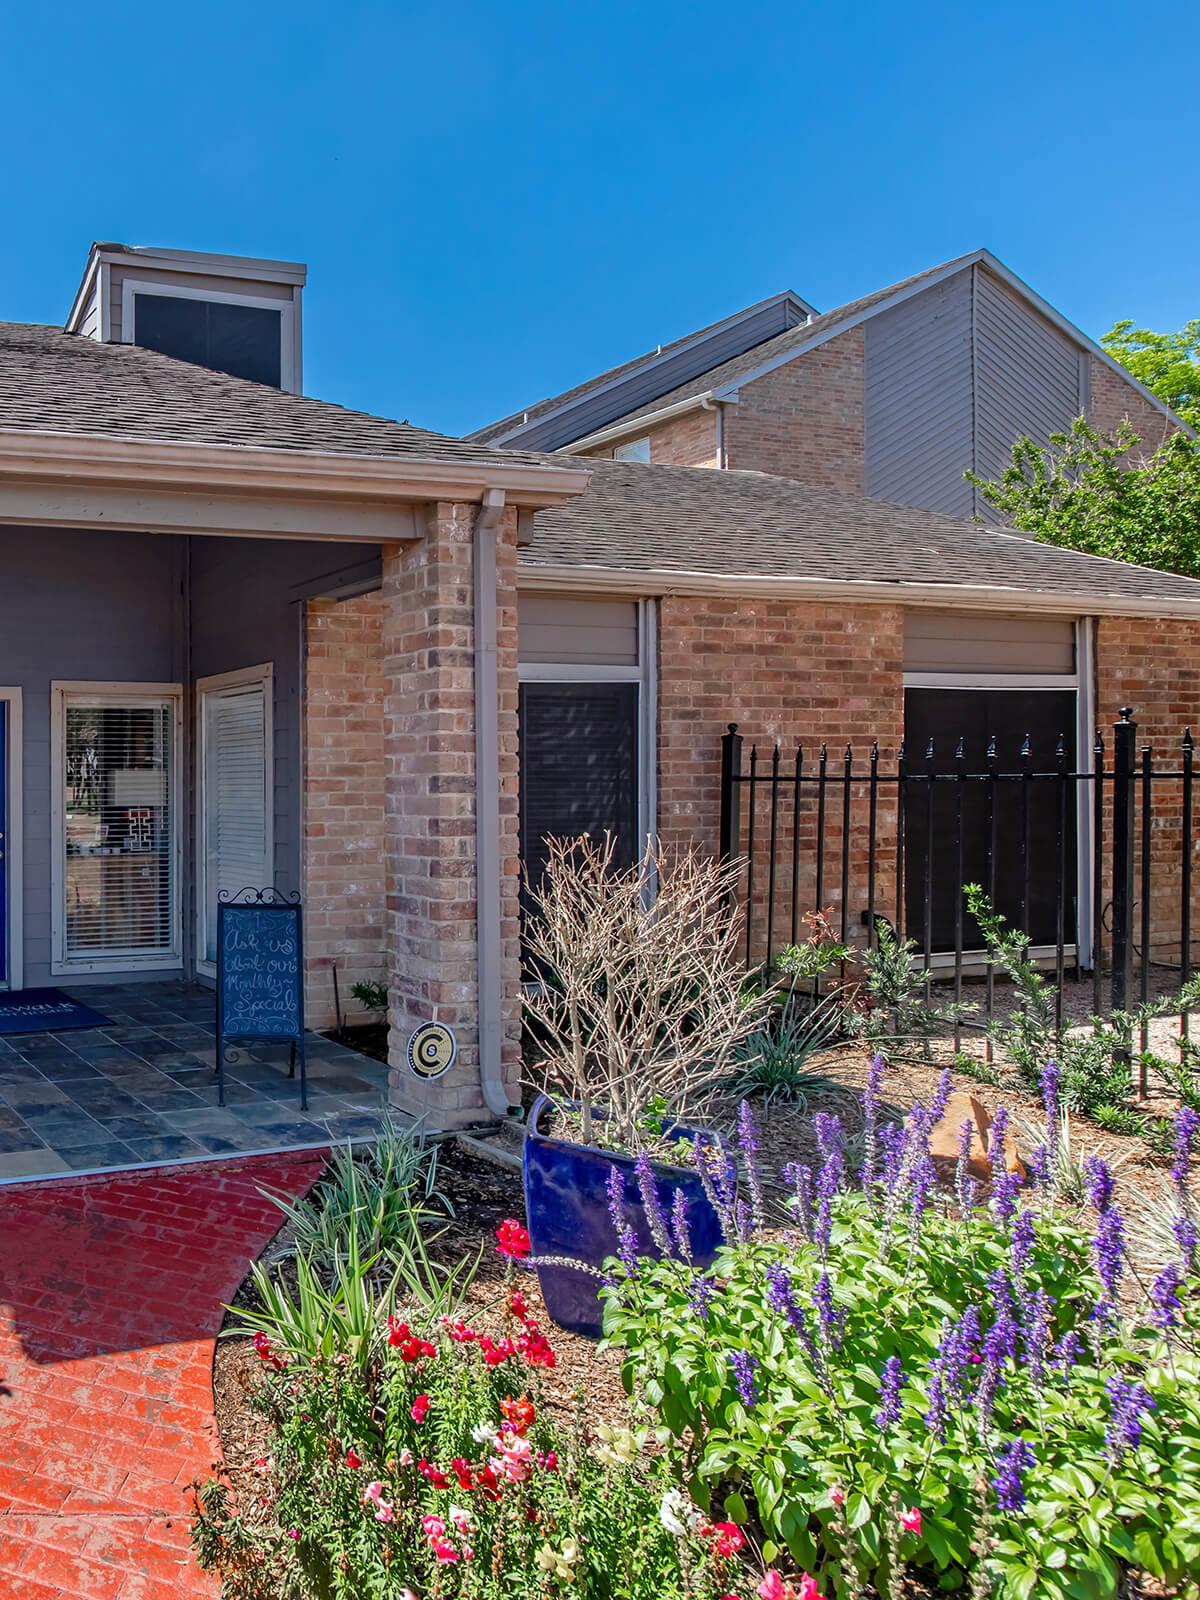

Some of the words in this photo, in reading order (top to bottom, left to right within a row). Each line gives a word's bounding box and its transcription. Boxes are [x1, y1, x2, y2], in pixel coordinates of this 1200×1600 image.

[225, 929, 260, 952] Ask
[270, 938, 294, 955] us
[225, 954, 265, 972] about
[267, 960, 297, 972] our
[233, 989, 297, 1018] Special
